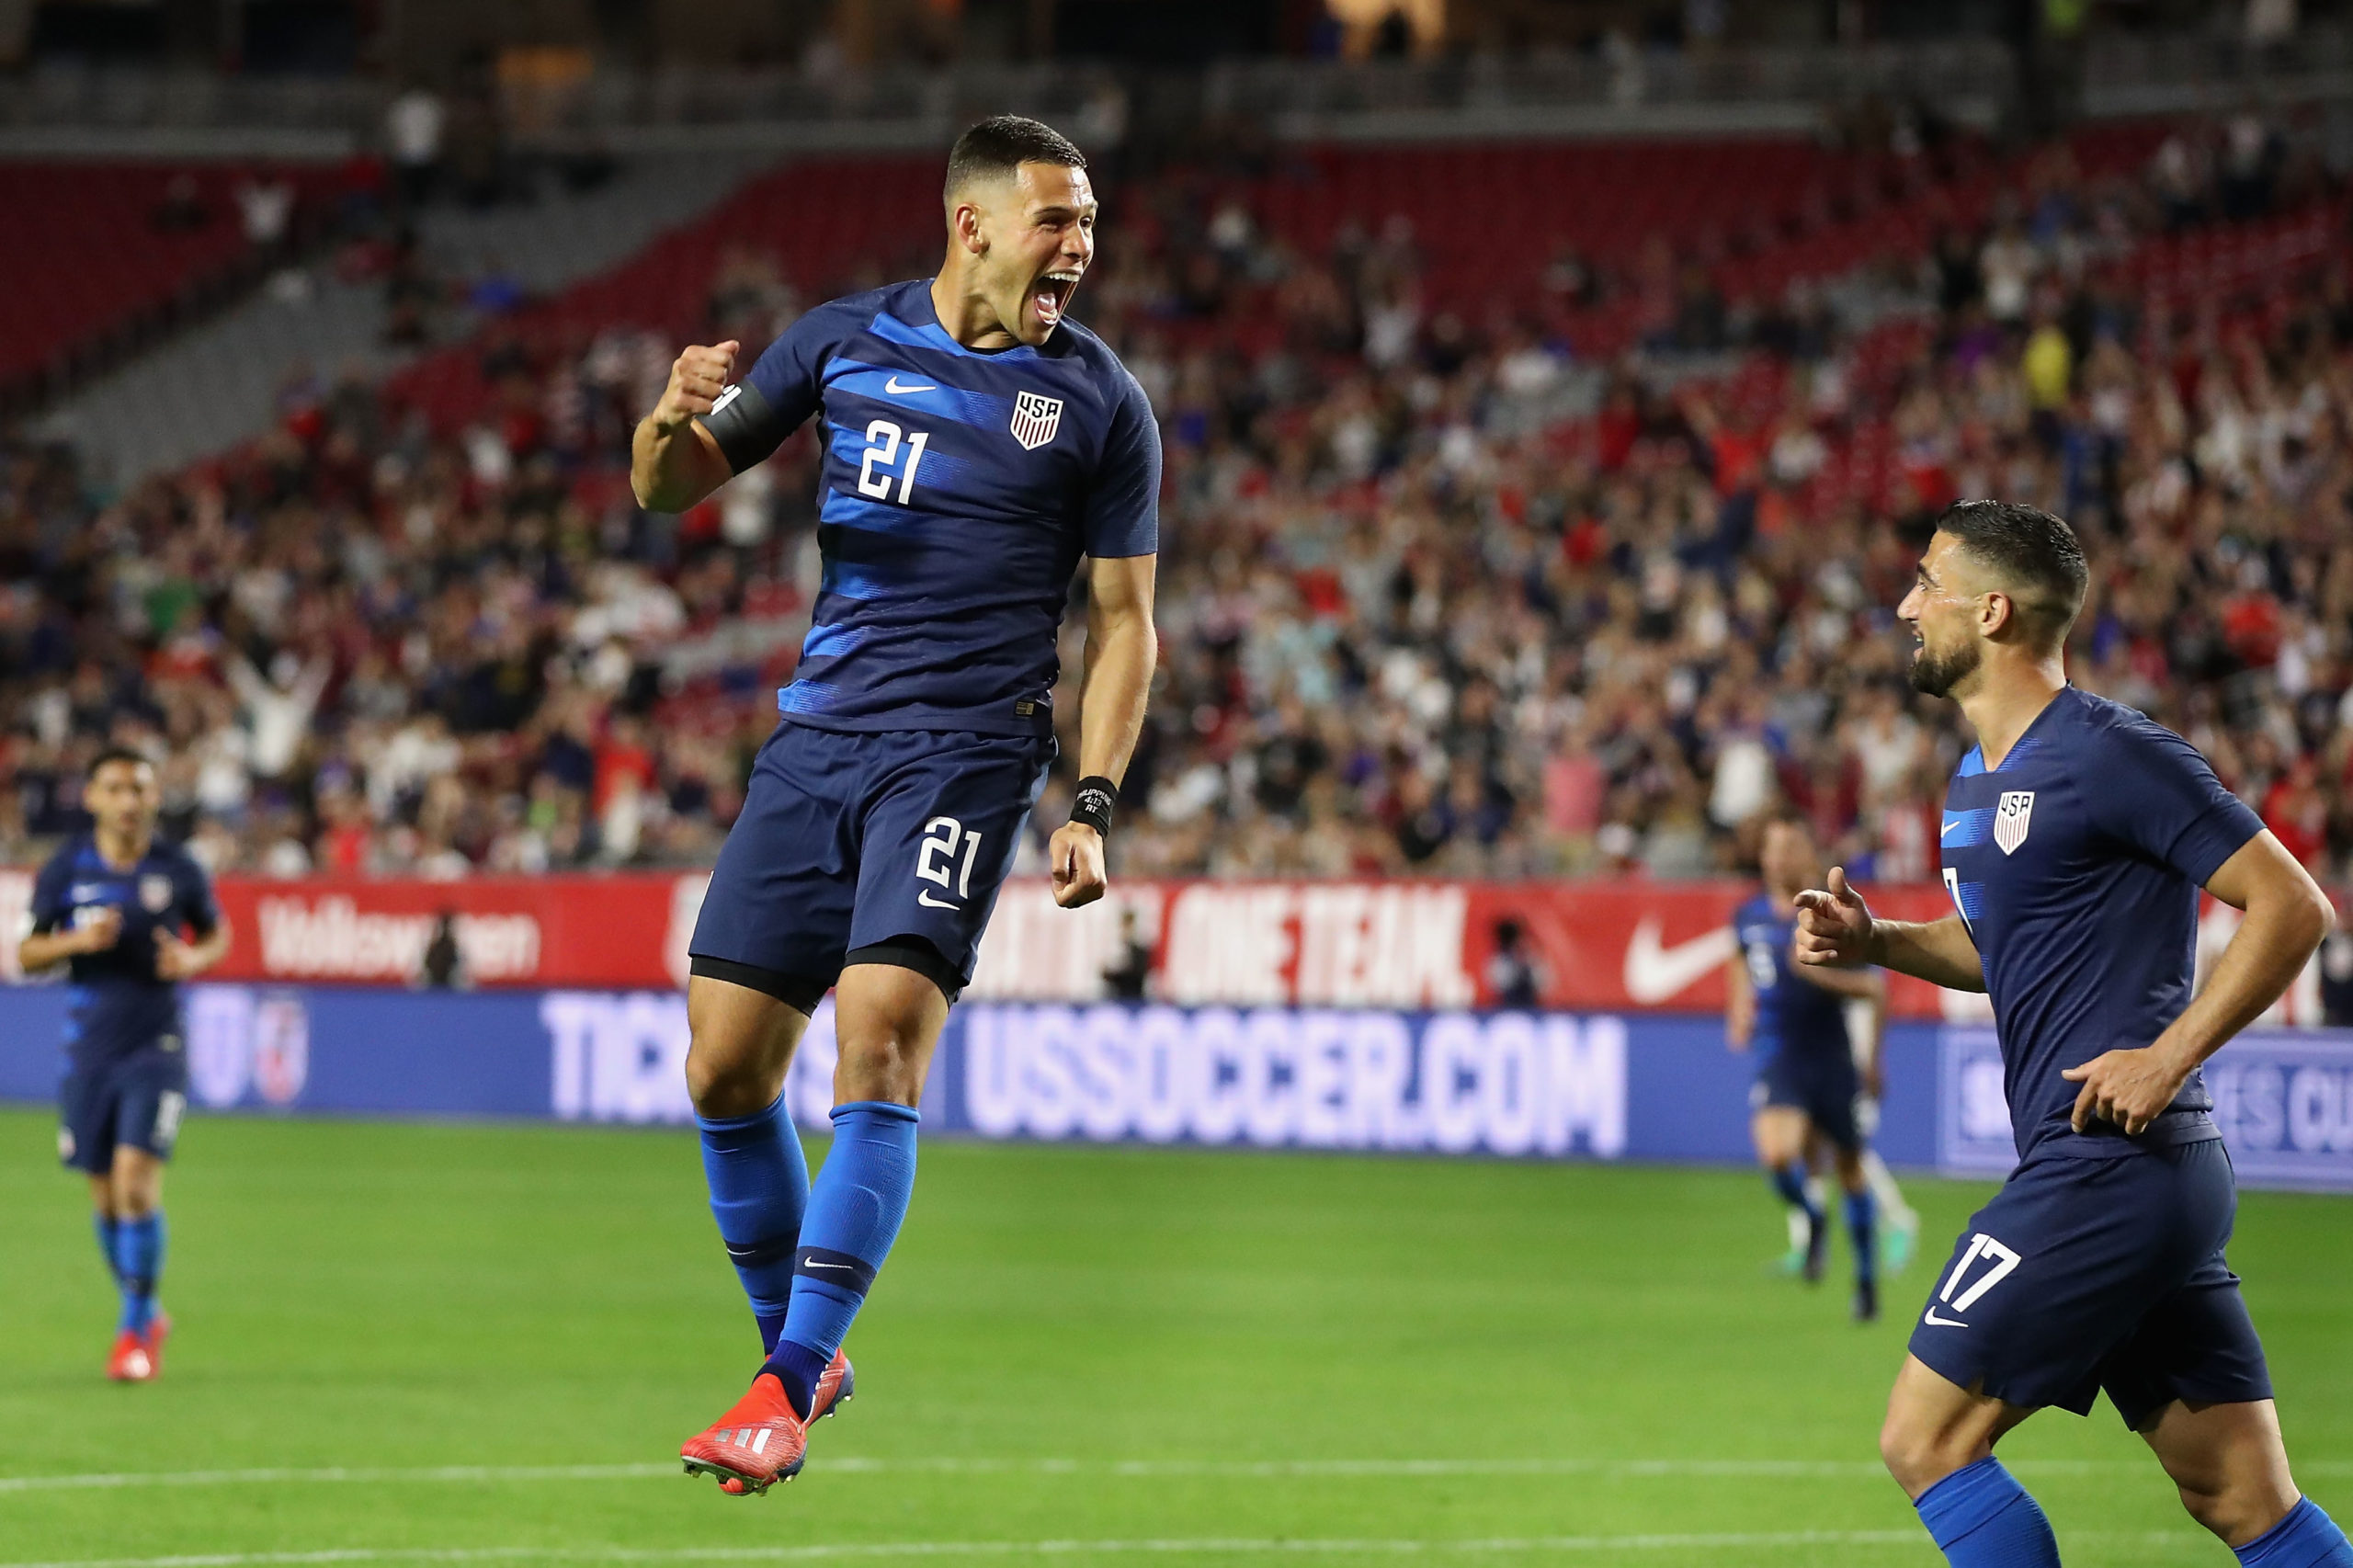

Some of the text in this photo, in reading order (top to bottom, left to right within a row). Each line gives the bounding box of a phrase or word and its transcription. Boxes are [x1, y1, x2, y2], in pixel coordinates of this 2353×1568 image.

[1018, 394, 1059, 418] USA
[858, 419, 929, 506] 21
[1084, 796, 1102, 807] 4:13
[2001, 794, 2031, 817] USA
[915, 816, 983, 900] 21
[256, 893, 540, 981] Volkswgen
[1167, 882, 1292, 1006] ONE
[965, 1004, 1628, 1159] USSOCCER.COM
[1938, 1233, 2022, 1313] 17
